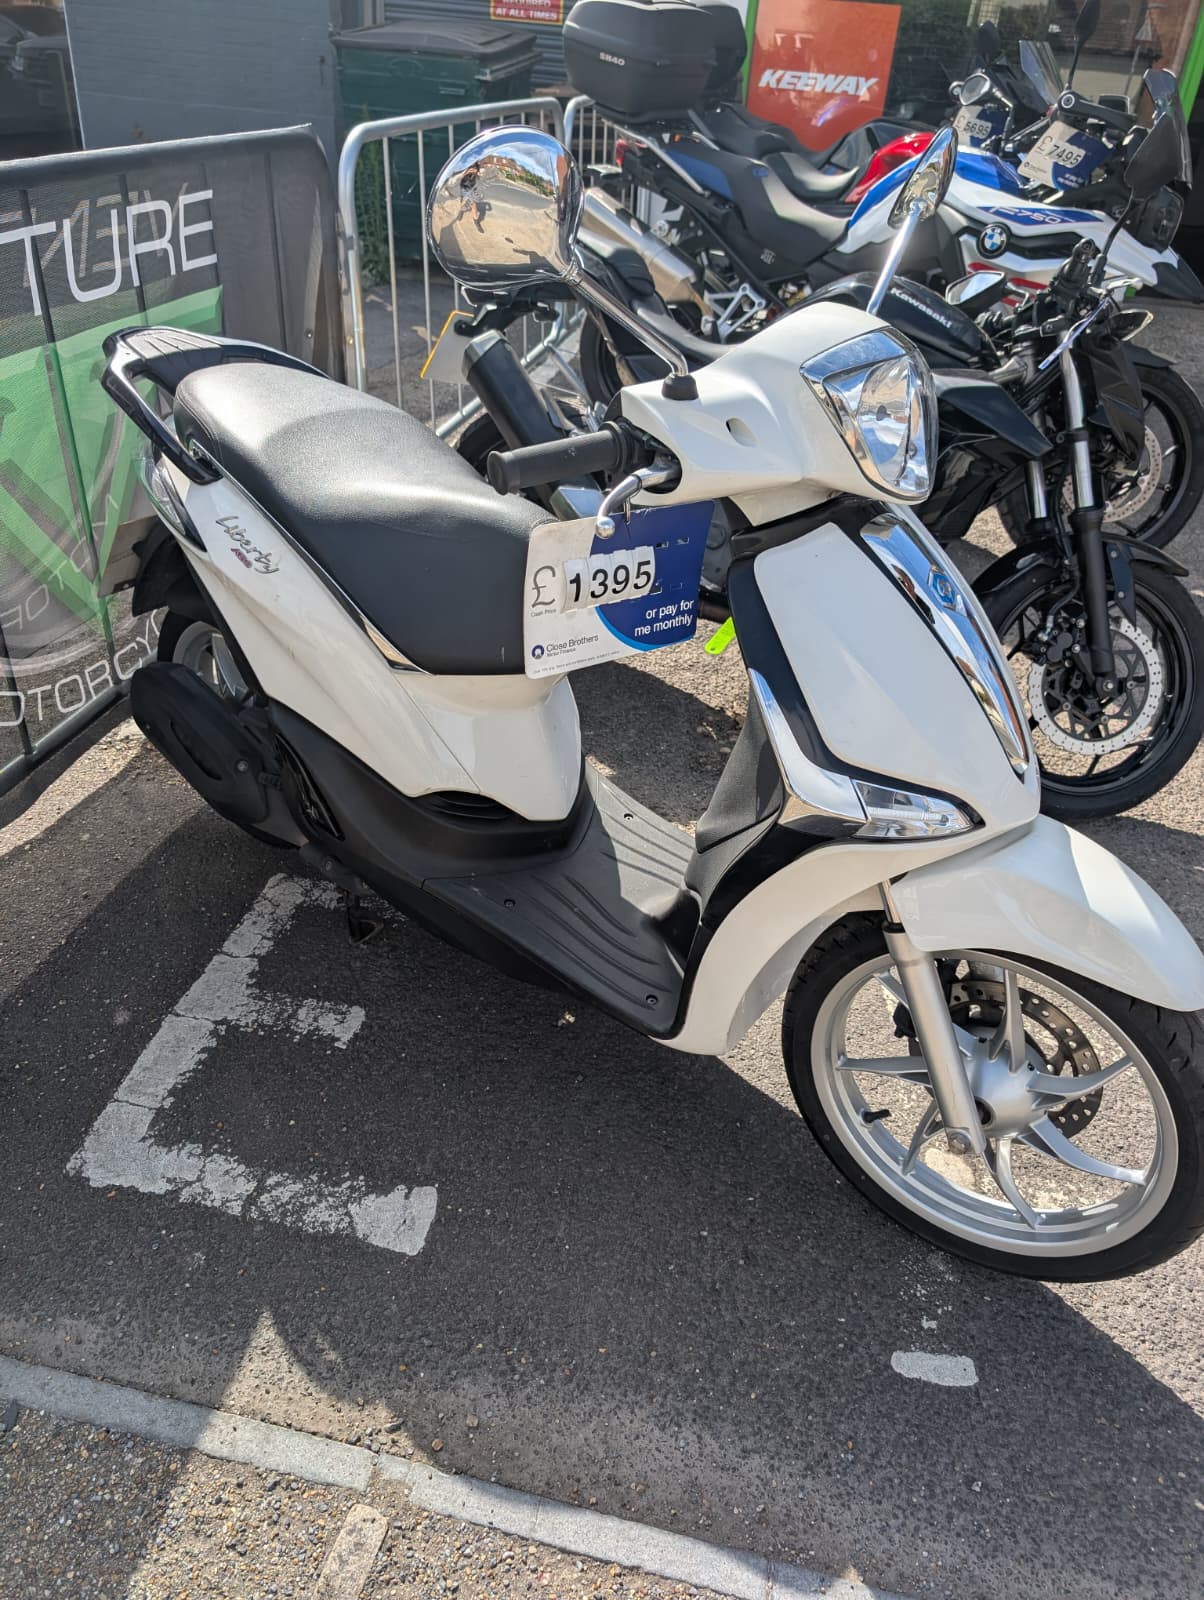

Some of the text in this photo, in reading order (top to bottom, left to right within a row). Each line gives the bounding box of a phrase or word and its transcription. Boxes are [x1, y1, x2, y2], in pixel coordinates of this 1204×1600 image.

[496, 8, 557, 20] AT ALL TIMES
[758, 69, 879, 96] KEEWAY
[1047, 144, 1082, 165] 7495
[0, 188, 218, 316] TURE
[890, 287, 953, 329] Kawasaki
[215, 515, 280, 574] Liberty
[569, 560, 652, 602] 1395
[646, 599, 694, 619] or pay for
[635, 613, 693, 637] me monthly
[546, 634, 599, 653] Close Brothers
